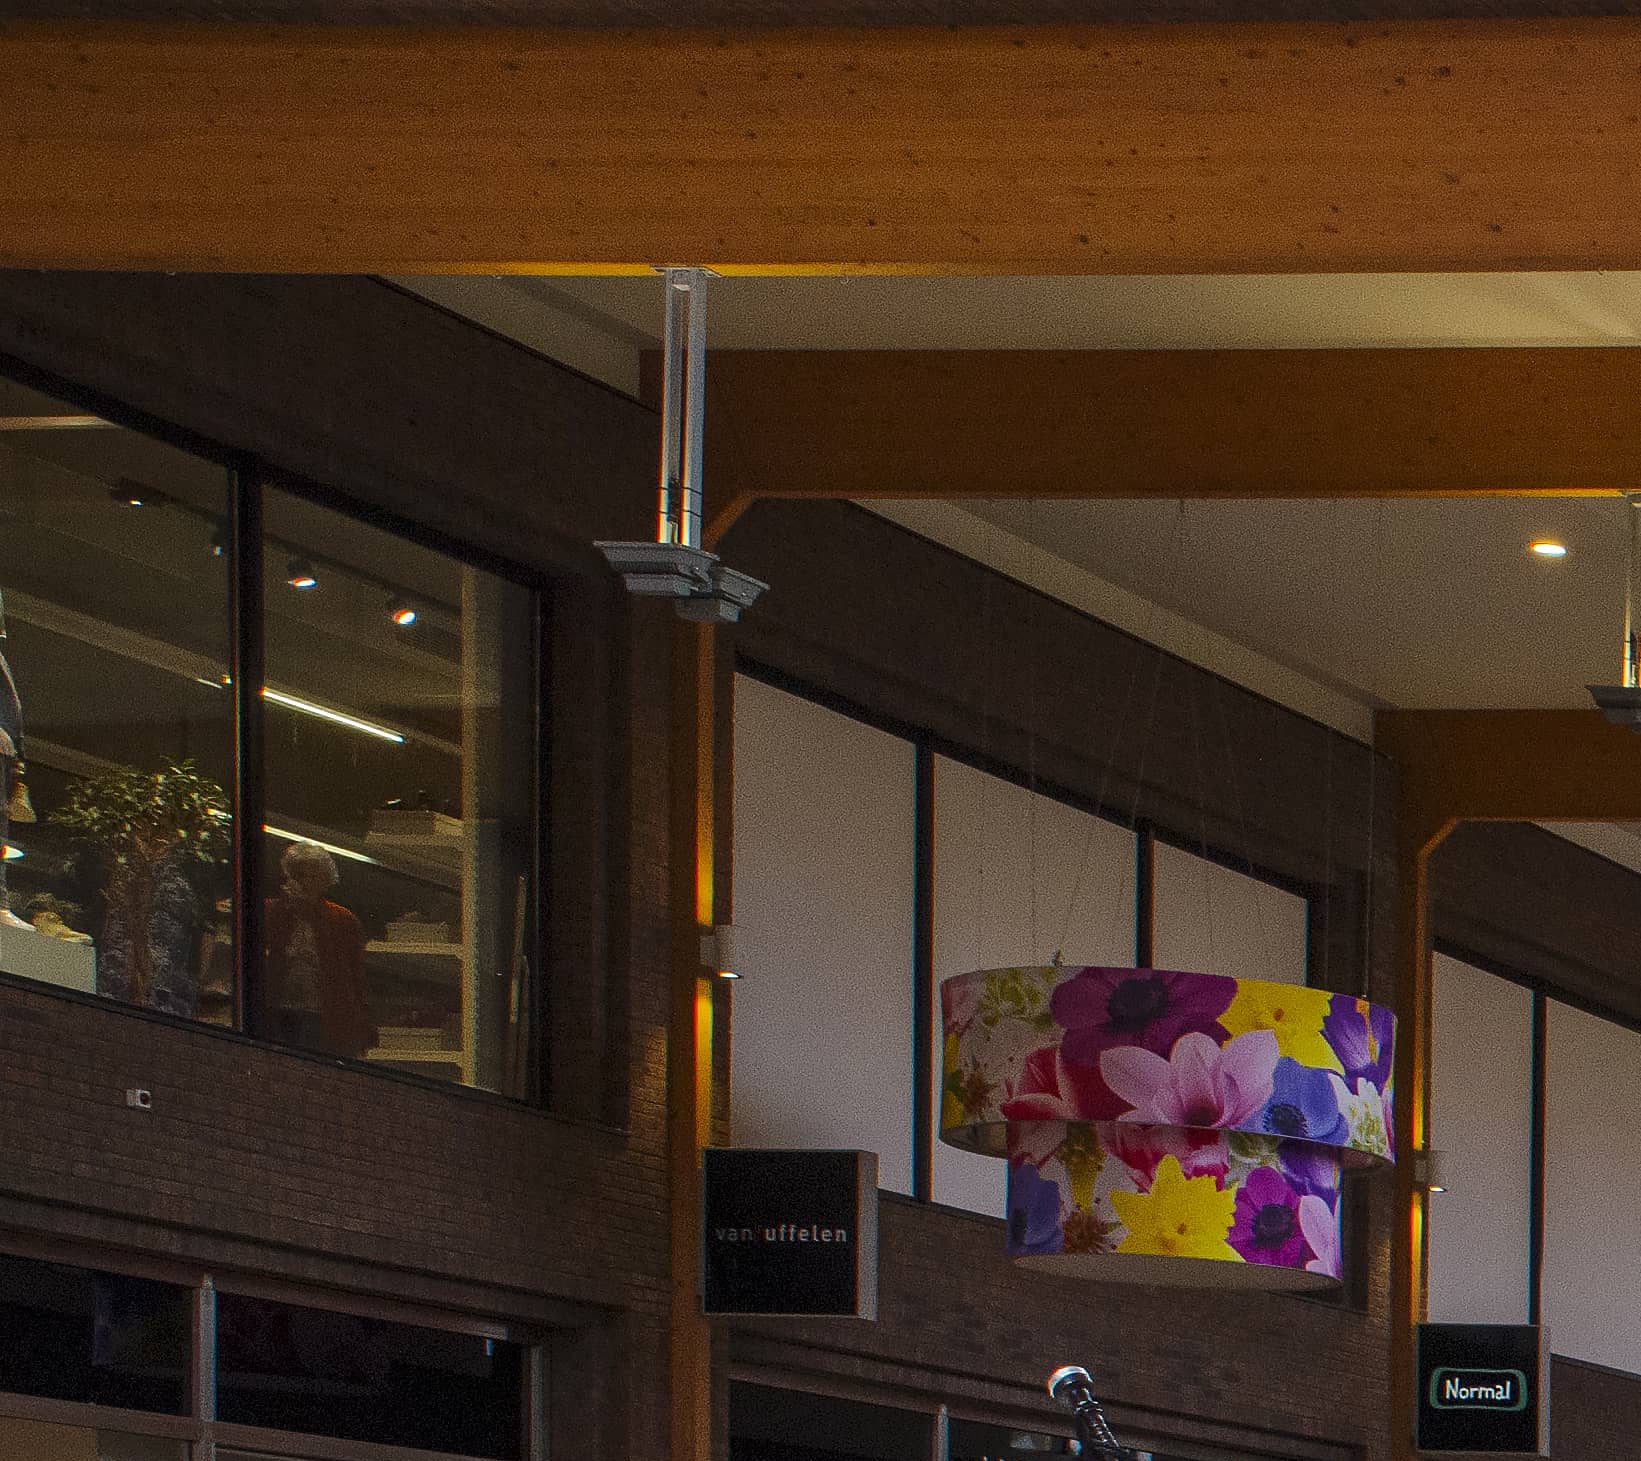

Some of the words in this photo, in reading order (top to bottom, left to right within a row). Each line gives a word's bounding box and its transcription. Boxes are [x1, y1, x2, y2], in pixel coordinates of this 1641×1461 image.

[714, 1228, 752, 1241] van
[764, 1224, 848, 1241] uffelen
[1445, 1377, 1511, 1400] Normal
